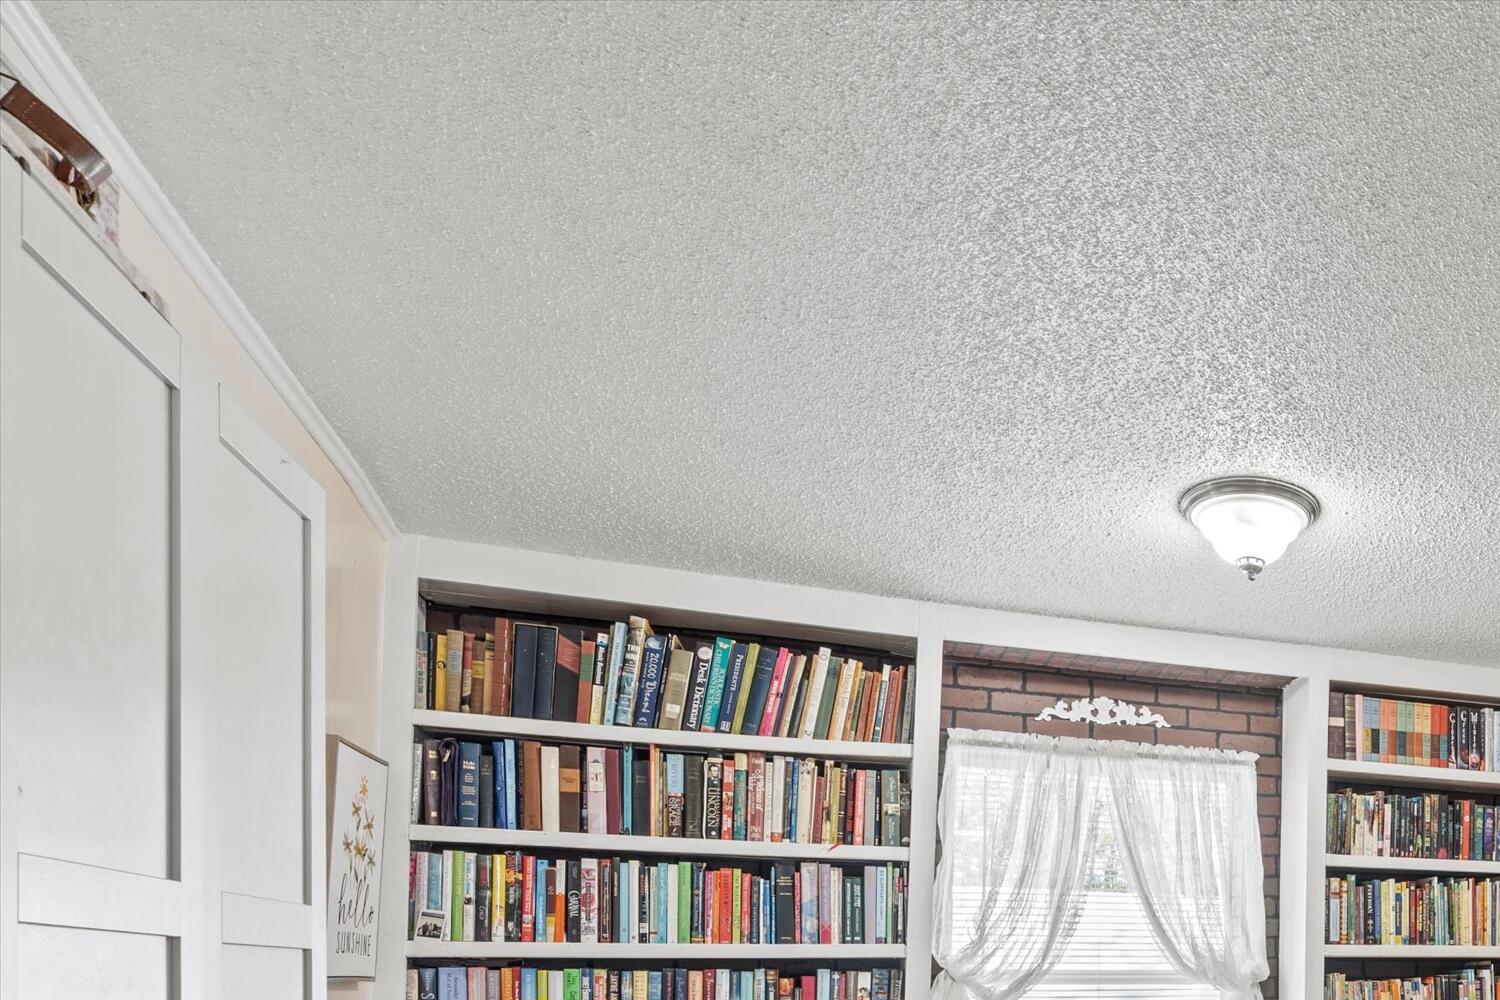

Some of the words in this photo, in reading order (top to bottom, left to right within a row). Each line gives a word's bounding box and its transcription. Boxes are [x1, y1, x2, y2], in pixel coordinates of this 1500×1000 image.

[696, 662, 709, 683] Desk
[687, 686, 705, 730] Dictionary
[668, 797, 677, 827] GRACE
[708, 787, 716, 828] LINCOLN
[338, 873, 374, 928] hello
[336, 931, 371, 957] SUNSHINE
[610, 975, 619, 992] JAYNE
